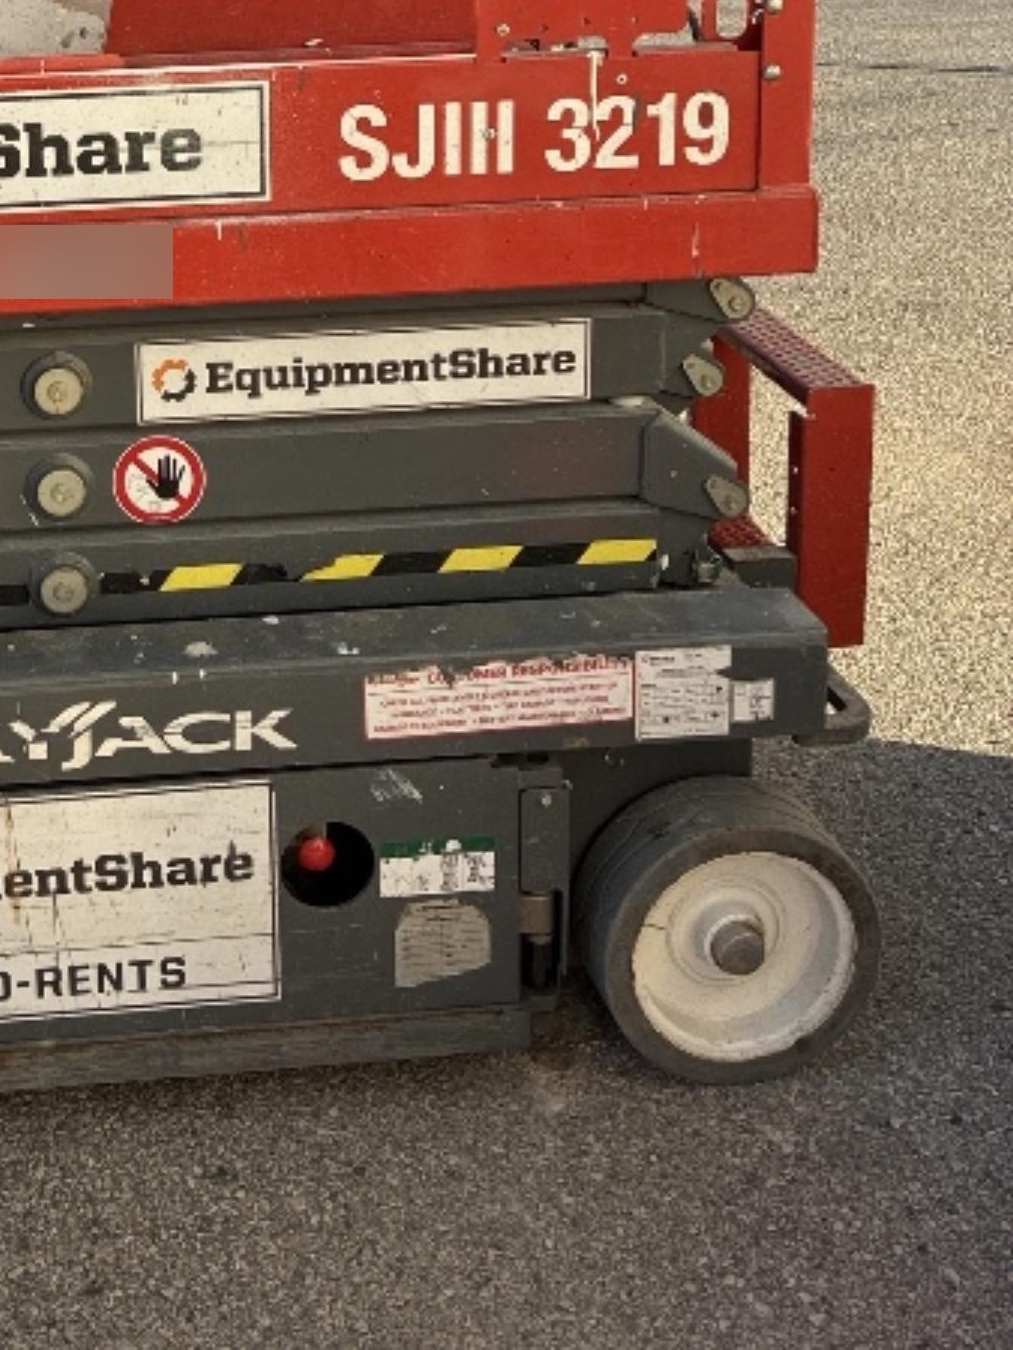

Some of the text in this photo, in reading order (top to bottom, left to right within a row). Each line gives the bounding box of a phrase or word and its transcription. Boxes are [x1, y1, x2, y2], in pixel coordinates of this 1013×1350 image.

[338, 90, 732, 182] SJIII 3219
[205, 347, 576, 397] EquipmentShare
